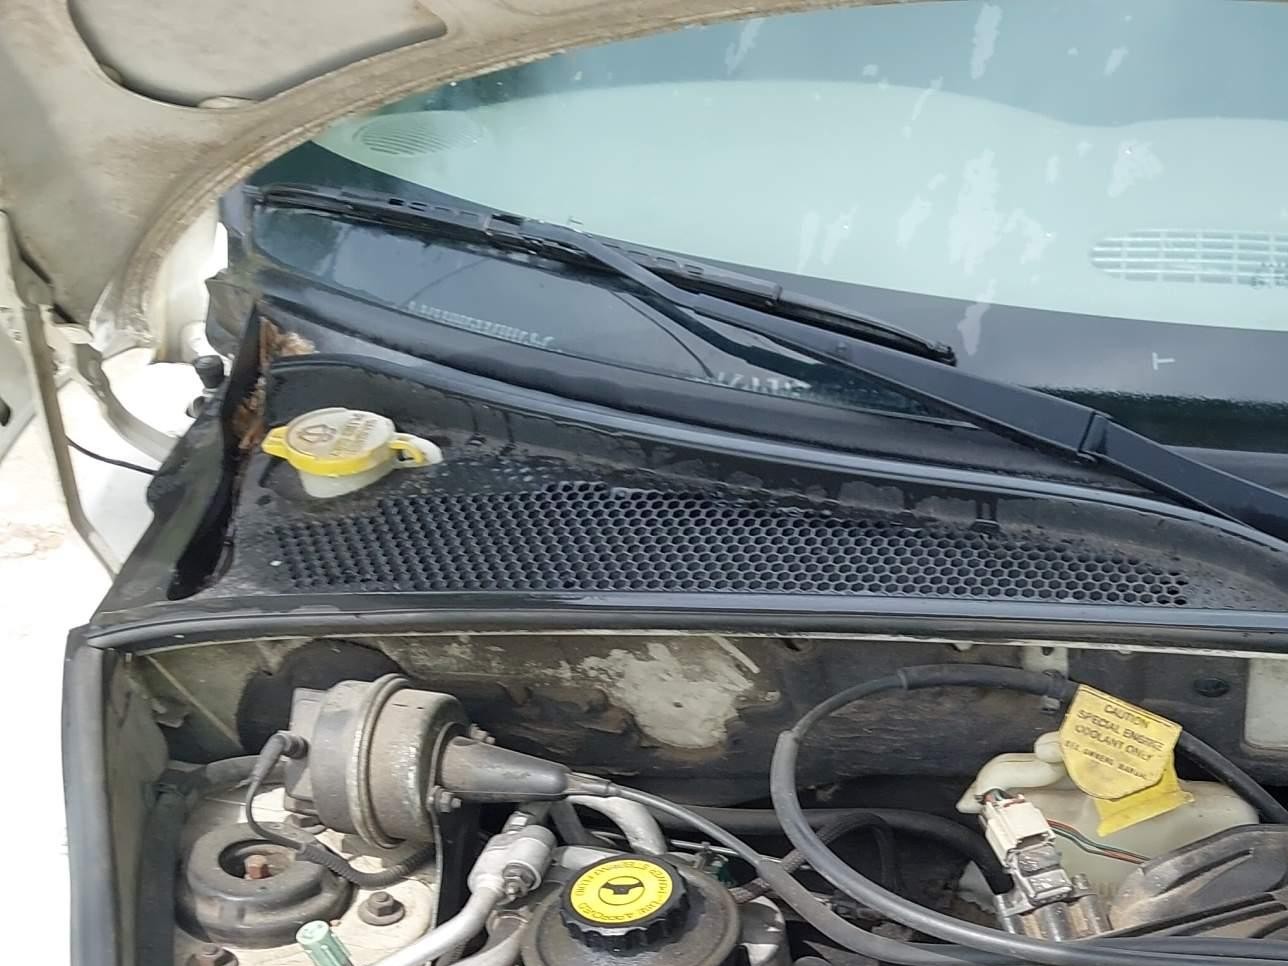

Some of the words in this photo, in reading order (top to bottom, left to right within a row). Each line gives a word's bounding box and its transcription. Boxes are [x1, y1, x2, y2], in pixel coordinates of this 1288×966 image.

[1077, 709, 1121, 735] SPECIAL
[1122, 728, 1165, 752] ENGINE
[1104, 704, 1150, 728] CAUTION
[1074, 724, 1125, 750] COOLANT
[1125, 744, 1154, 761] ONLY
